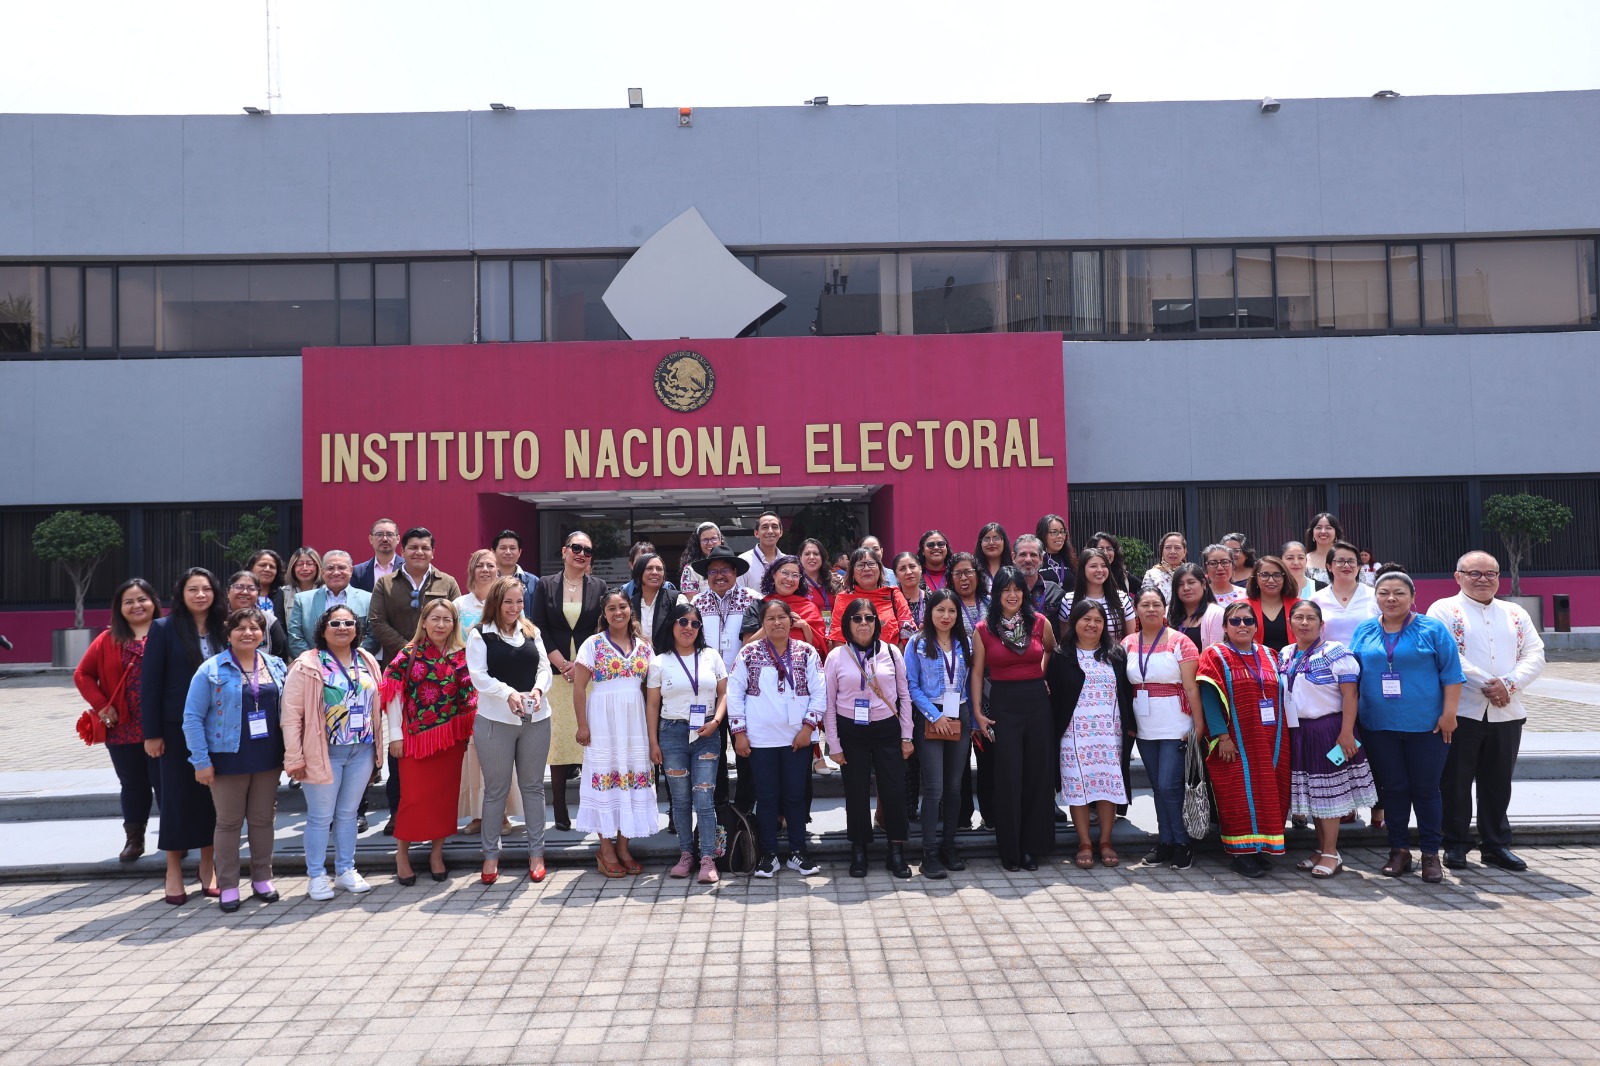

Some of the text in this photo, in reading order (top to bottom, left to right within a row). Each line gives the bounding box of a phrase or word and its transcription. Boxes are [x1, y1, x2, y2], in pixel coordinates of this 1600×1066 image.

[654, 351, 715, 381] ESTADOS UNIDOS MEXICANOS
[321, 418, 1055, 483] INSTITUTO NACIONAL ELECTORAL
